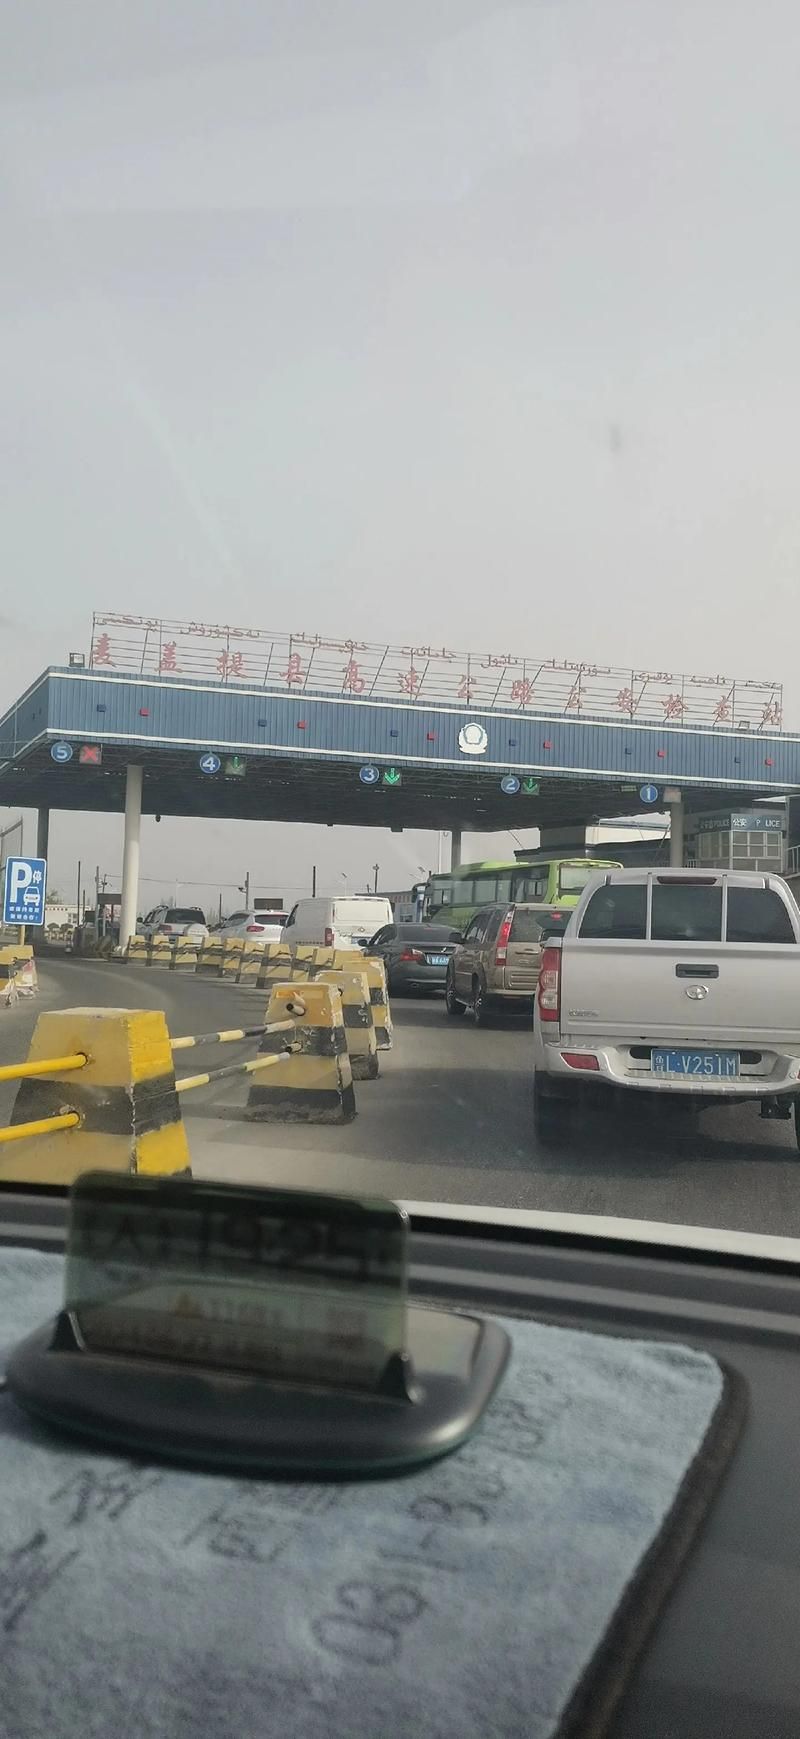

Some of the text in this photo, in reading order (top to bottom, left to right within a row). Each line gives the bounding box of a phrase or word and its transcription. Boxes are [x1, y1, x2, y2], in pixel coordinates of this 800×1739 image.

[56, 746, 68, 759] 5
[202, 756, 216, 771] 4
[363, 769, 376, 781] 3
[505, 778, 516, 791] 2
[9, 861, 33, 903] P
